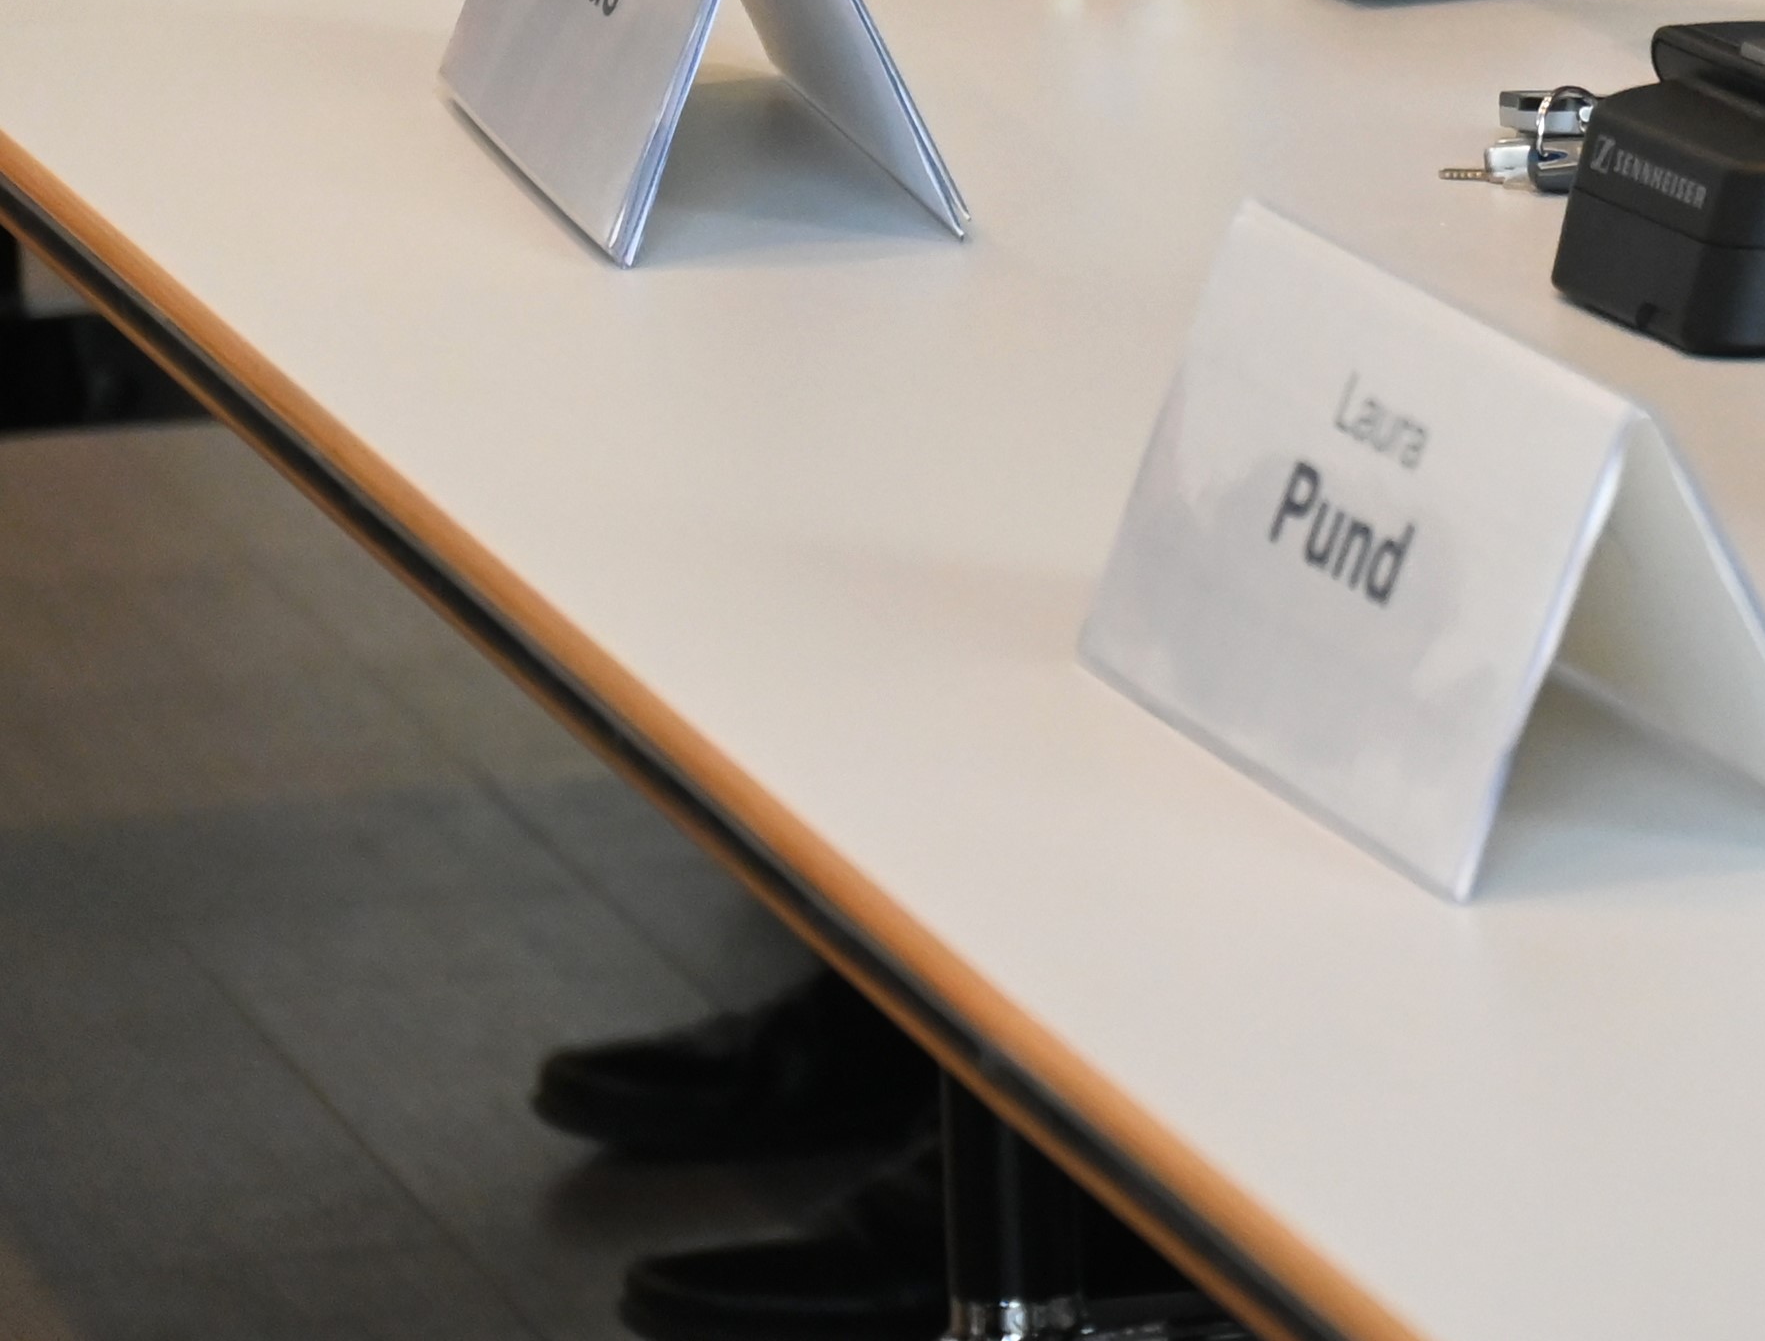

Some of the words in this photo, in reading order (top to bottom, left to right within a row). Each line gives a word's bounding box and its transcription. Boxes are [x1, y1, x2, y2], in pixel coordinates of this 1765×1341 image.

[1613, 149, 1707, 210] SENNHEISER
[1333, 371, 1431, 470] Laura
[1268, 460, 1416, 608] Pund
